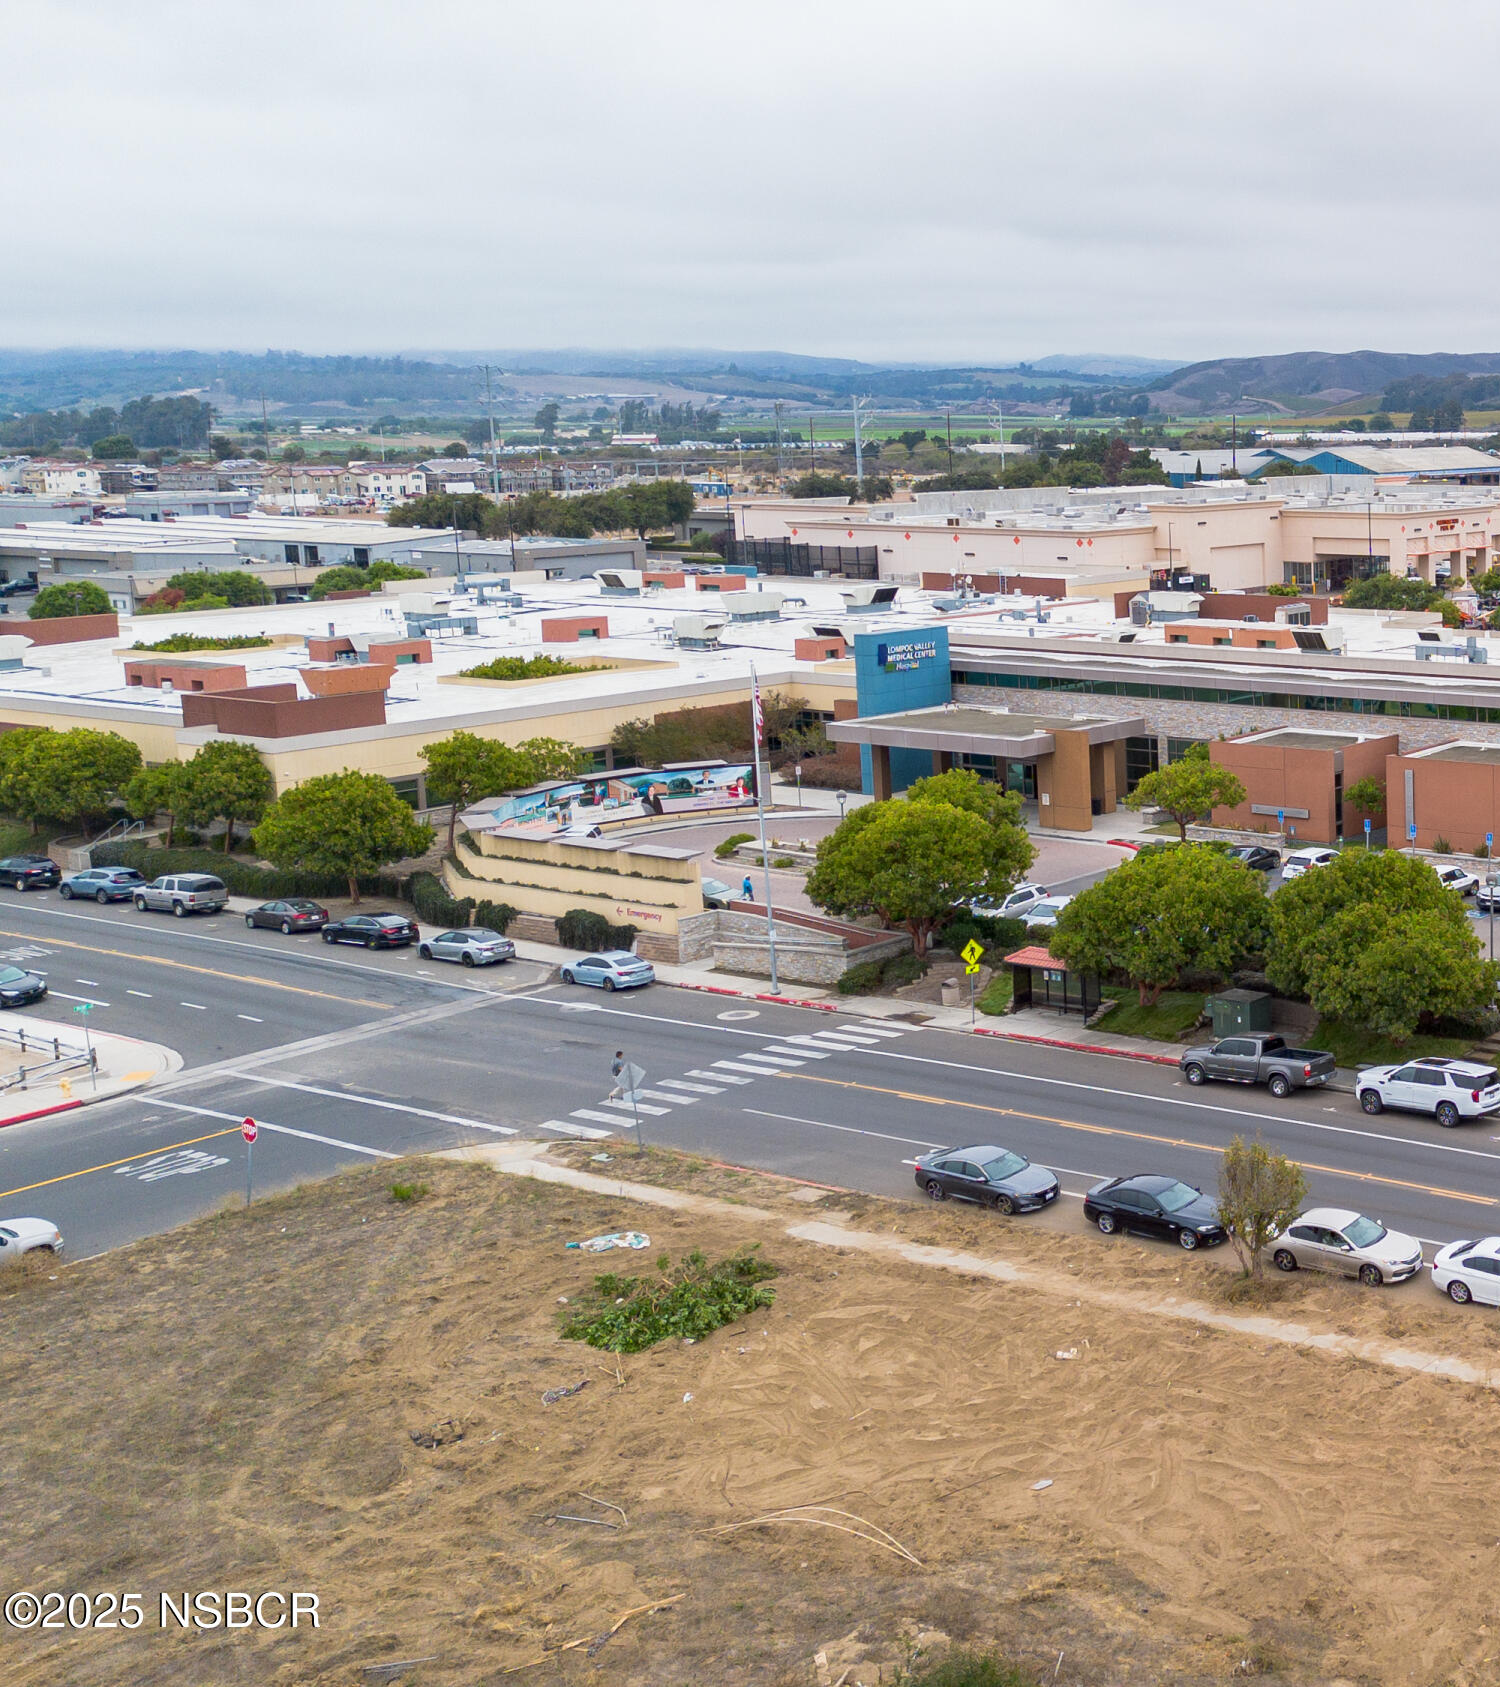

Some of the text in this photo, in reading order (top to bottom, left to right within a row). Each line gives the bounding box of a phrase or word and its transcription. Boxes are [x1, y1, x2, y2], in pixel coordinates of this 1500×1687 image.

[887, 649, 936, 662] MEDICAL CENTER
[626, 908, 662, 922] Emergency
[242, 1123, 257, 1136] STOP
